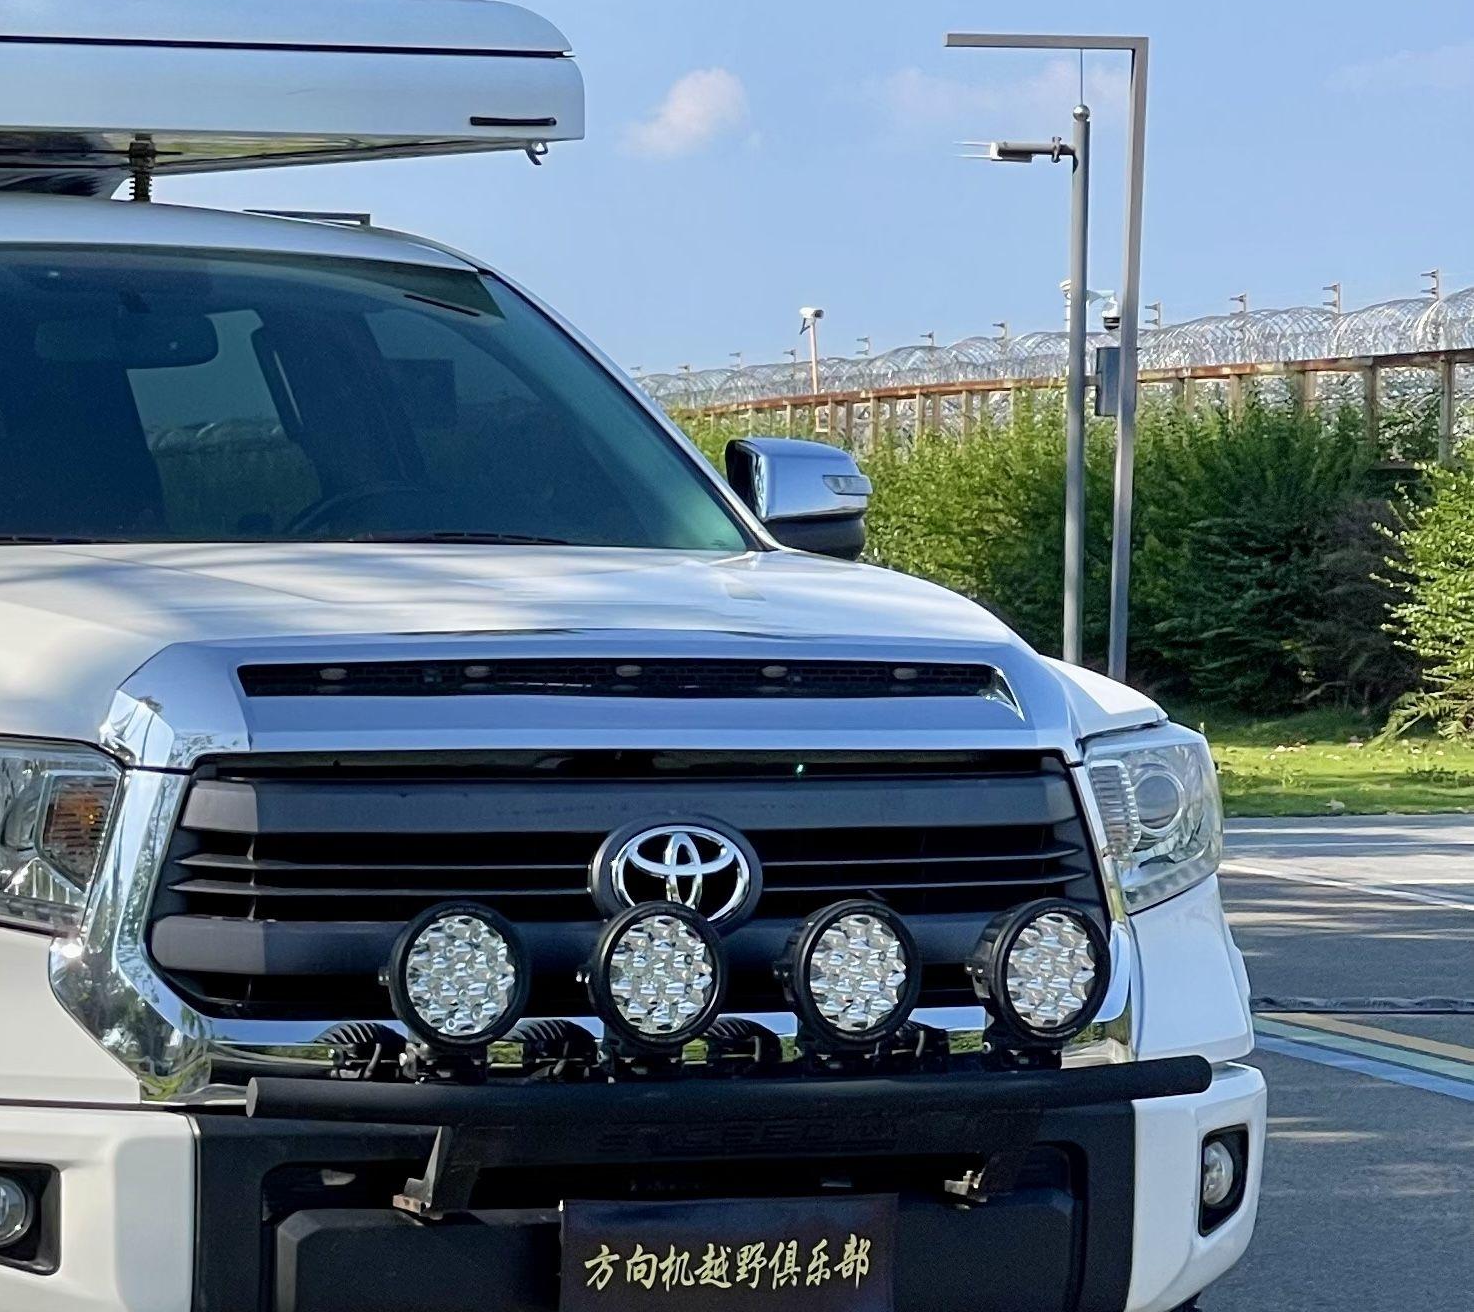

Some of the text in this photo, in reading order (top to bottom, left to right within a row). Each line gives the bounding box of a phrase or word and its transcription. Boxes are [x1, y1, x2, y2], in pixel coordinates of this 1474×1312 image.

[584, 1233, 872, 1291] 方向机越野俱乐部
